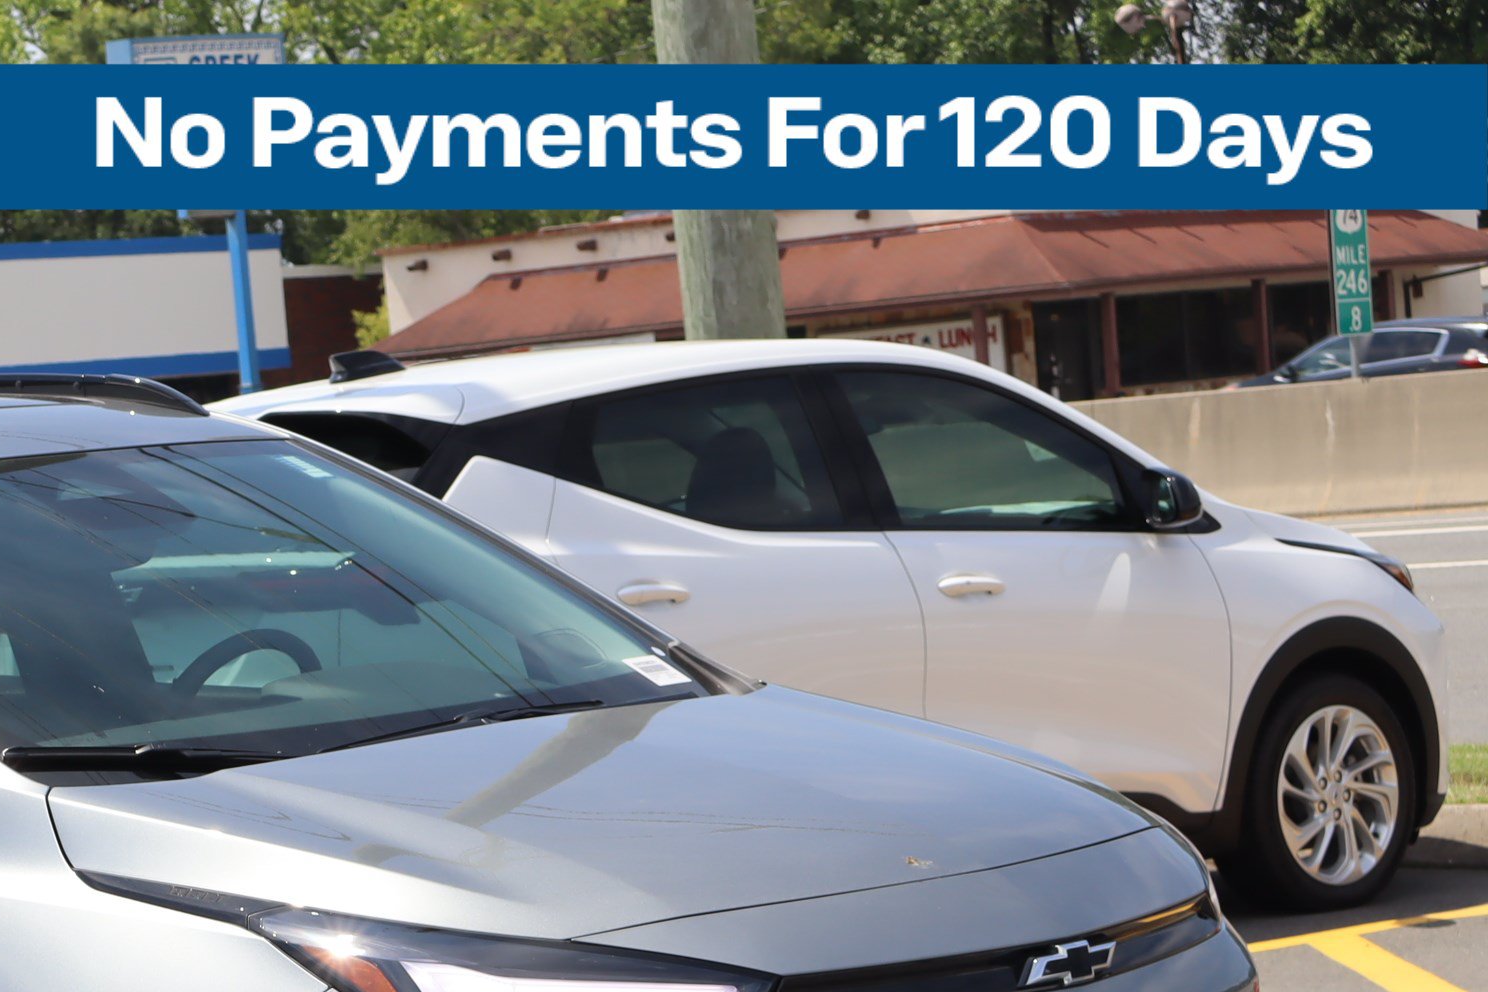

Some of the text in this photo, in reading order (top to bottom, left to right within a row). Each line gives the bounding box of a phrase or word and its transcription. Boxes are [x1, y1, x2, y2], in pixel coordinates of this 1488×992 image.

[1336, 245, 1366, 265] MILE
[1337, 269, 1368, 295] 246
[938, 324, 998, 348] LUNH
